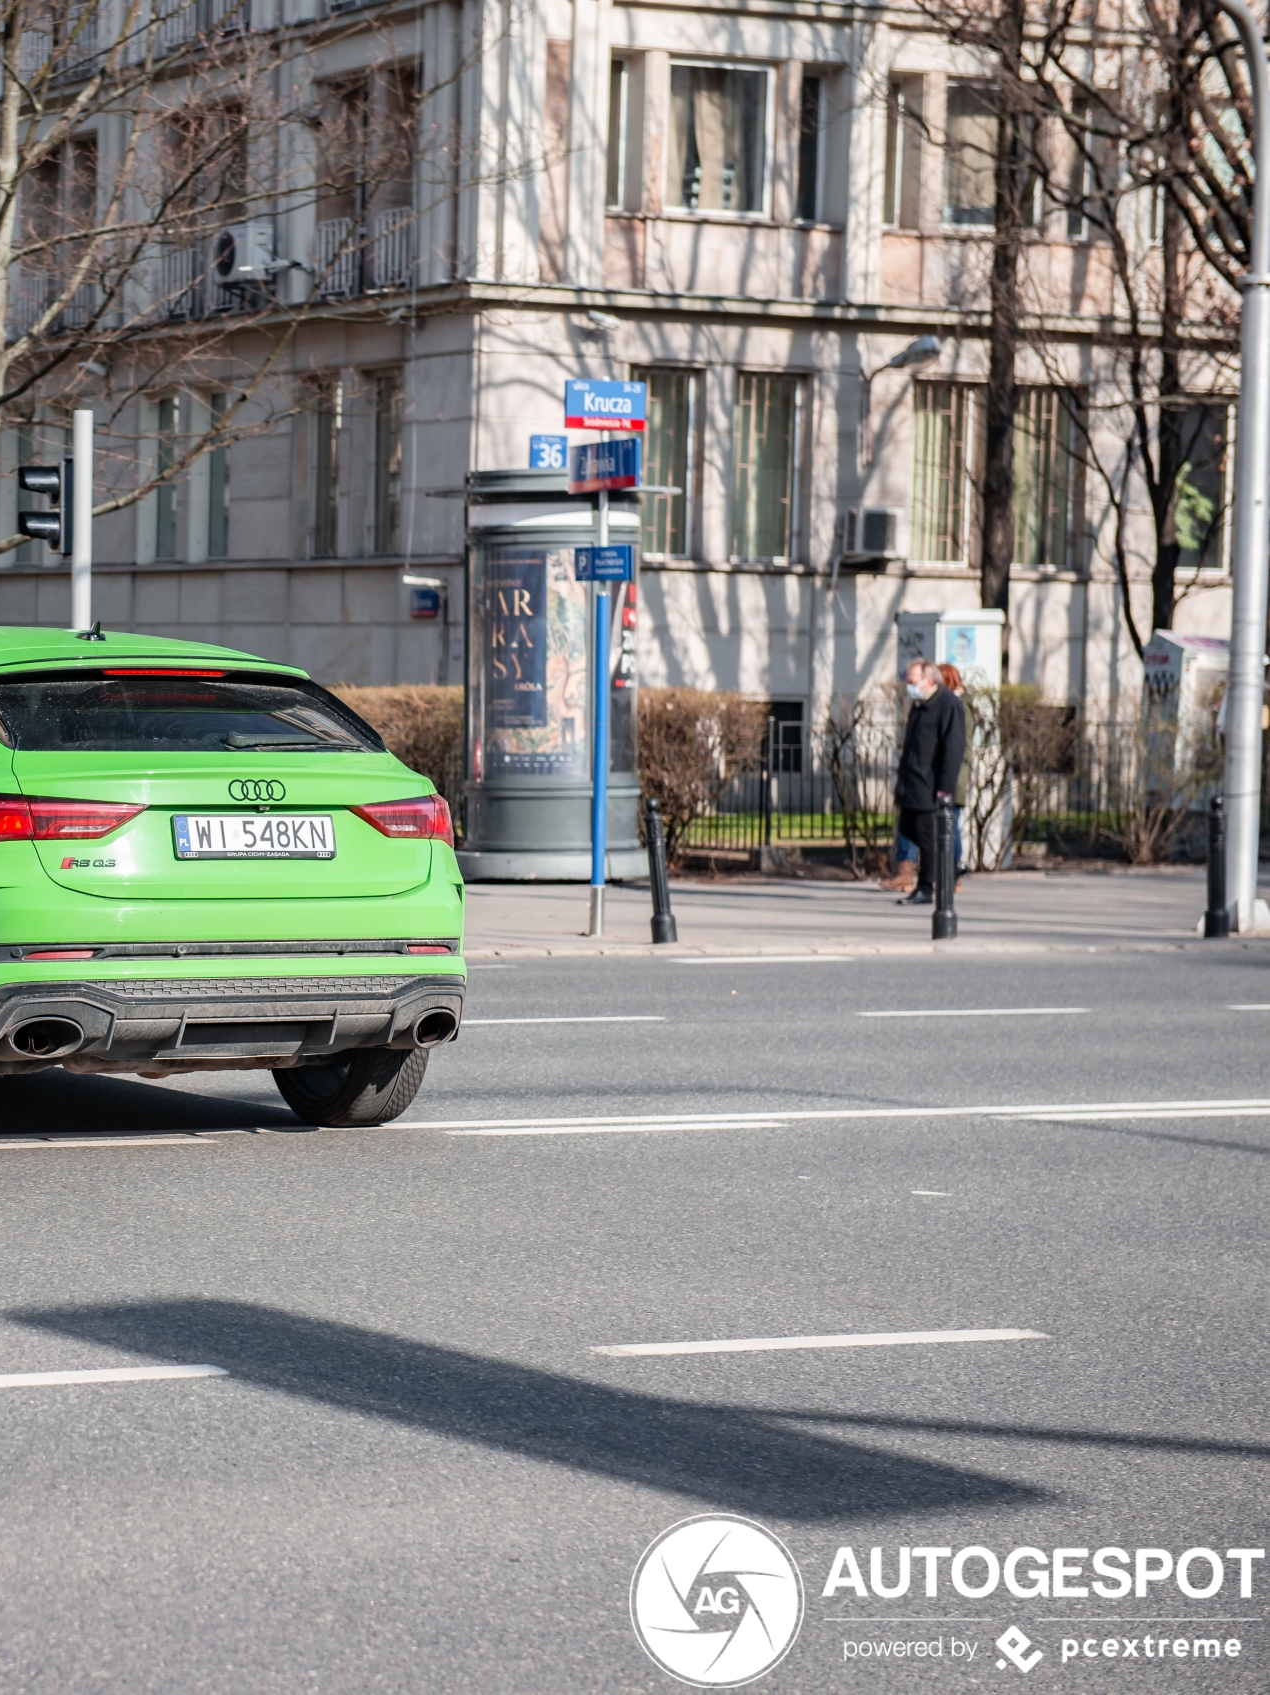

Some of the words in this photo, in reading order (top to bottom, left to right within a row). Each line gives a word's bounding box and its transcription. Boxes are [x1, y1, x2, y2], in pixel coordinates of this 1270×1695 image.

[584, 391, 632, 414] Krucza
[537, 443, 563, 469] 36
[179, 838, 190, 847] PL
[195, 820, 226, 848] WI
[242, 820, 327, 849] 548KN
[68, 859, 91, 868] RS
[93, 859, 117, 868] Q3
